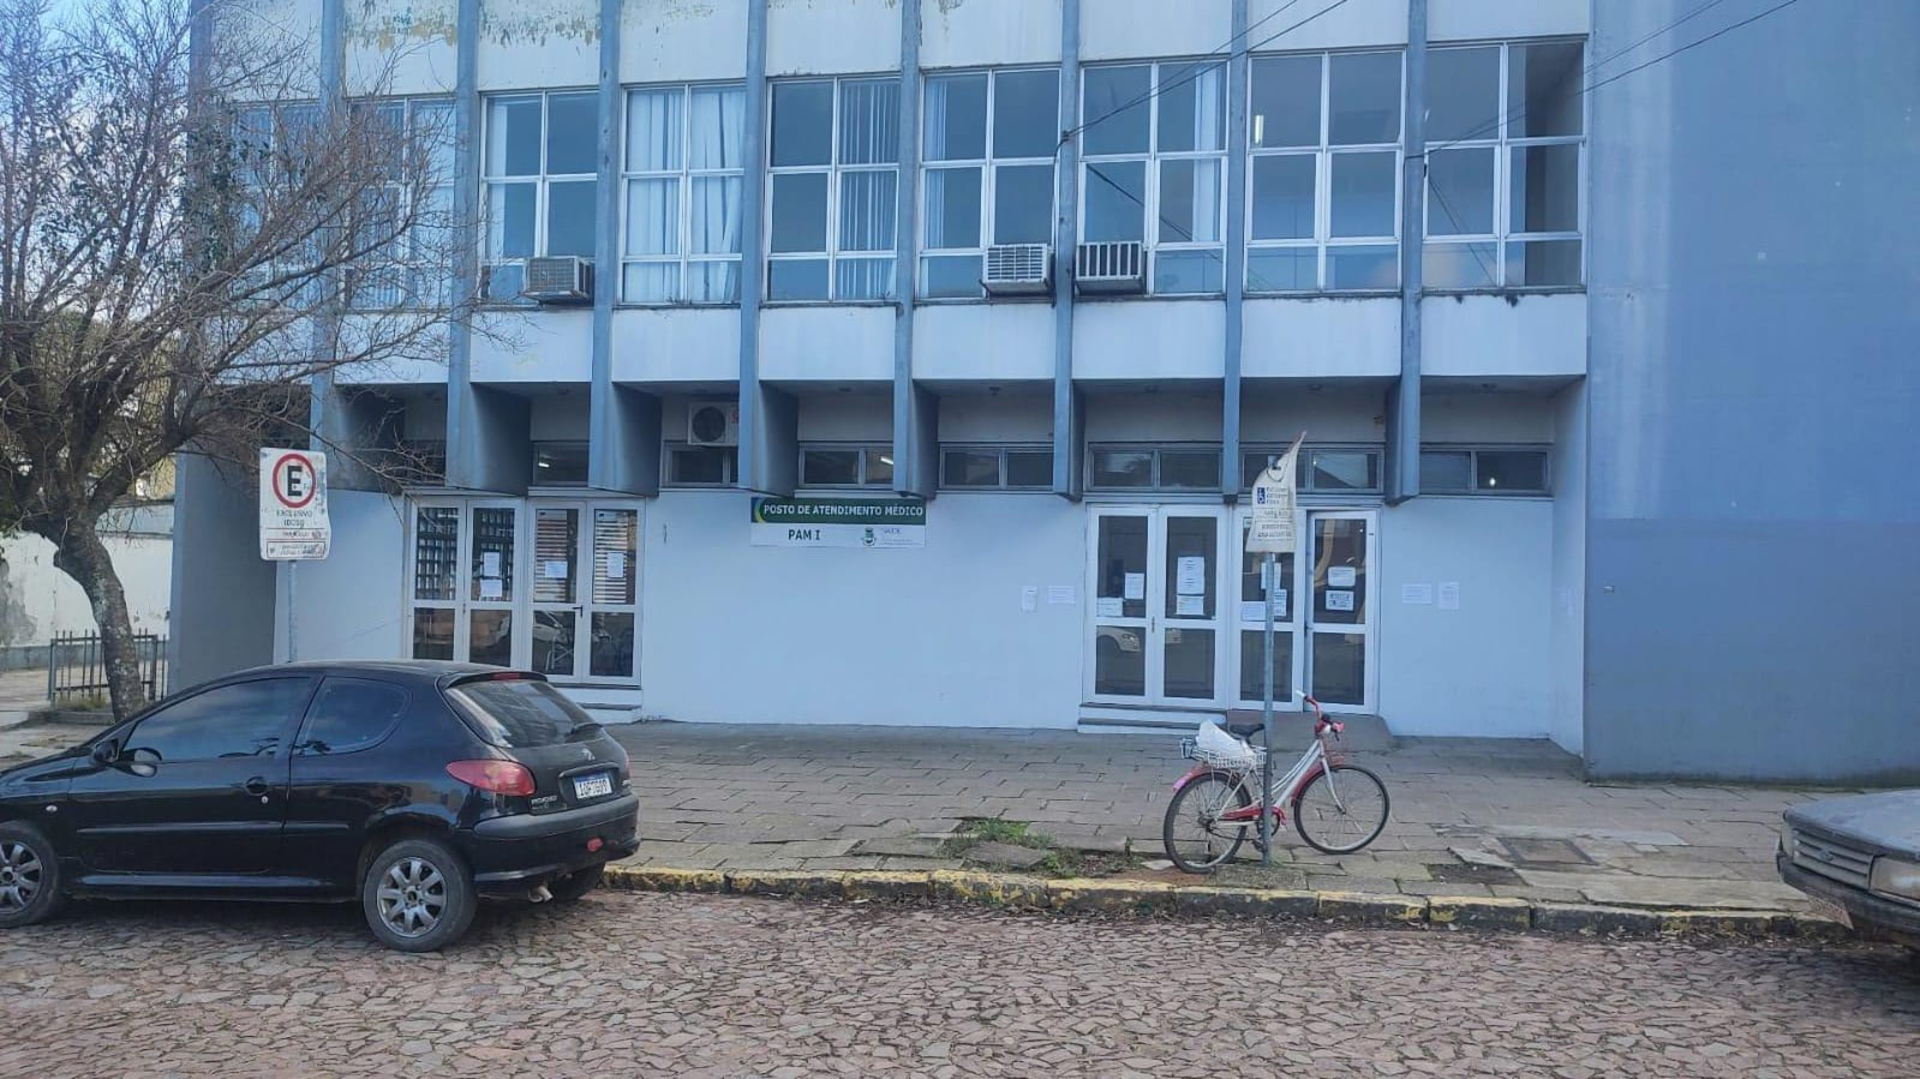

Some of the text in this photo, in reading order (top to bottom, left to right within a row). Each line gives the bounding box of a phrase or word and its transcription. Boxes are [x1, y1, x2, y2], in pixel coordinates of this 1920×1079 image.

[287, 465, 303, 497] E
[764, 503, 923, 516] POSTO DE ATENDIMENTO MÉDICO
[788, 528, 821, 541] PAM I
